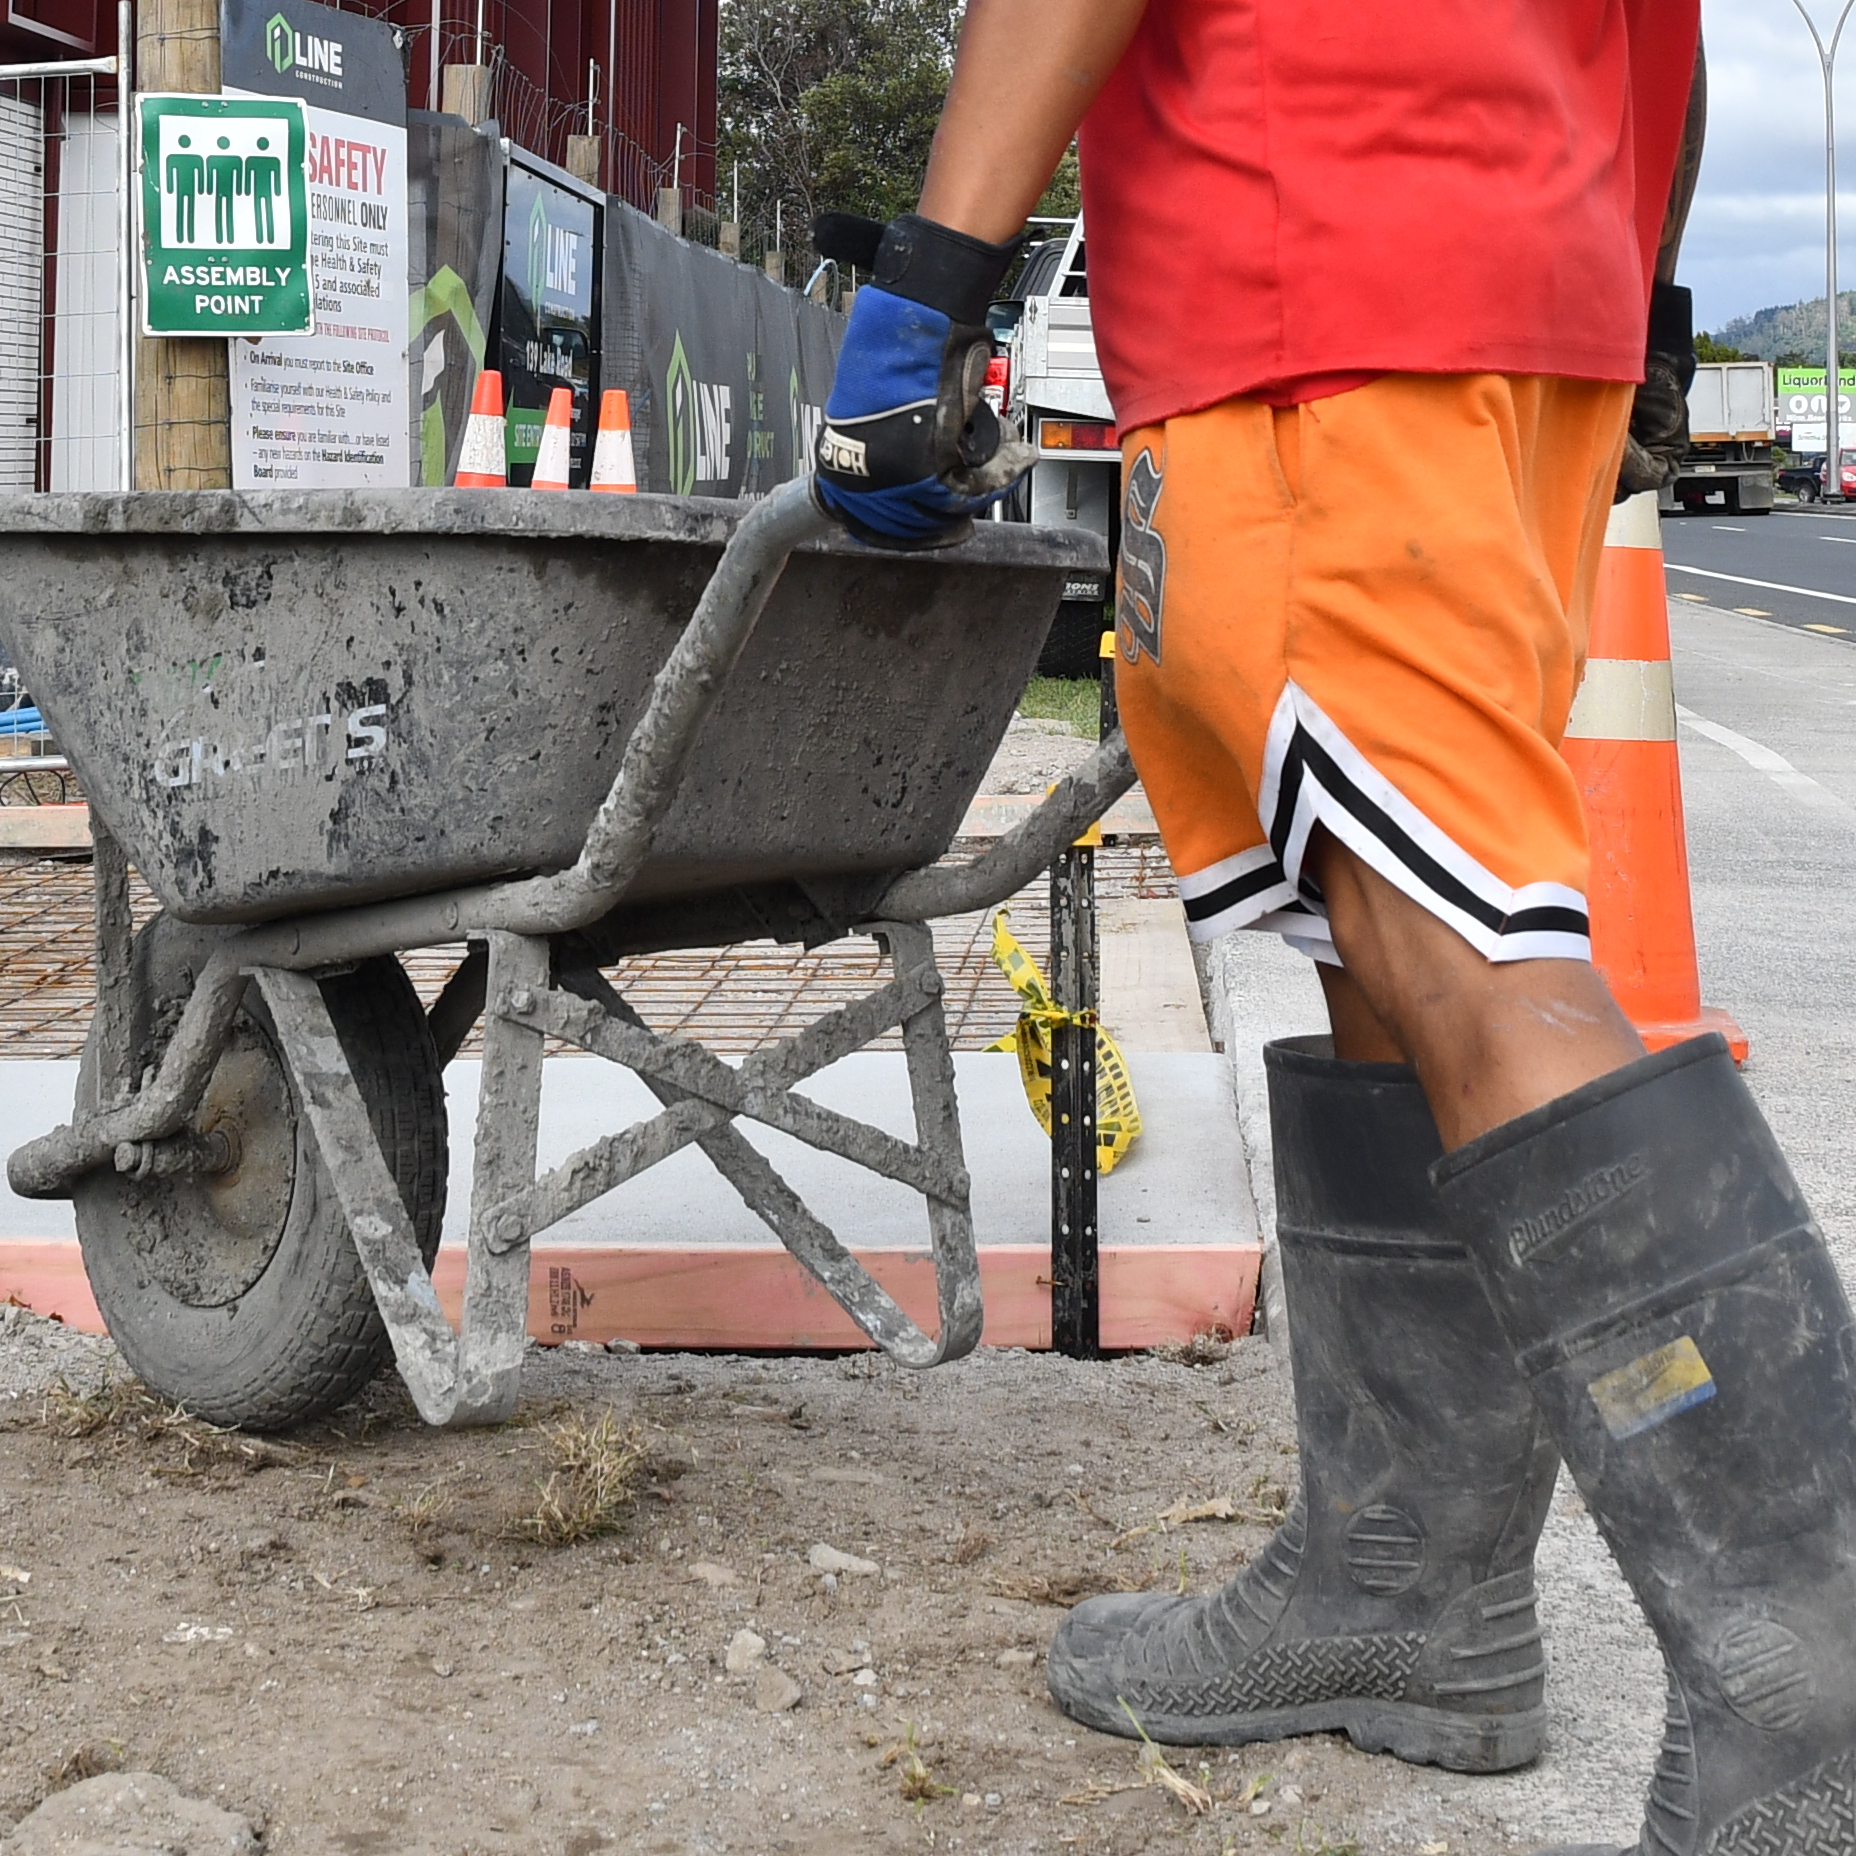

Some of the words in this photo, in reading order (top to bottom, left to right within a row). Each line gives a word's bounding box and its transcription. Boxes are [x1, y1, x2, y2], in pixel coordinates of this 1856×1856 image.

[295, 70, 343, 90] CONSTRUCTION
[309, 131, 387, 196] SAFETY
[311, 193, 358, 227] ERSONNEL
[360, 202, 389, 232] ONLY
[311, 230, 334, 250] tering
[336, 233, 351, 252] this
[352, 235, 368, 254] Site
[369, 240, 389, 258] must
[163, 265, 292, 287] ASSEMBLY
[321, 253, 347, 272] Health
[357, 259, 382, 280] Safety
[322, 274, 338, 291] and
[339, 277, 380, 299] associated
[195, 294, 264, 315] POINT
[315, 297, 342, 314] lations
[250, 350, 260, 364] On
[261, 351, 282, 367] Arrival
[283, 357, 294, 371] you
[342, 360, 355, 373] Site
[356, 361, 374, 375] Office
[539, 342, 556, 375] Lake
[1782, 373, 1856, 389] Liquorlnd
[252, 425, 273, 441] Please
[274, 430, 296, 442] ensure
[322, 448, 343, 463] Hazard
[344, 449, 384, 465] Identification
[253, 464, 273, 479] Board
[1509, 1151, 1647, 1260] Blundstone
